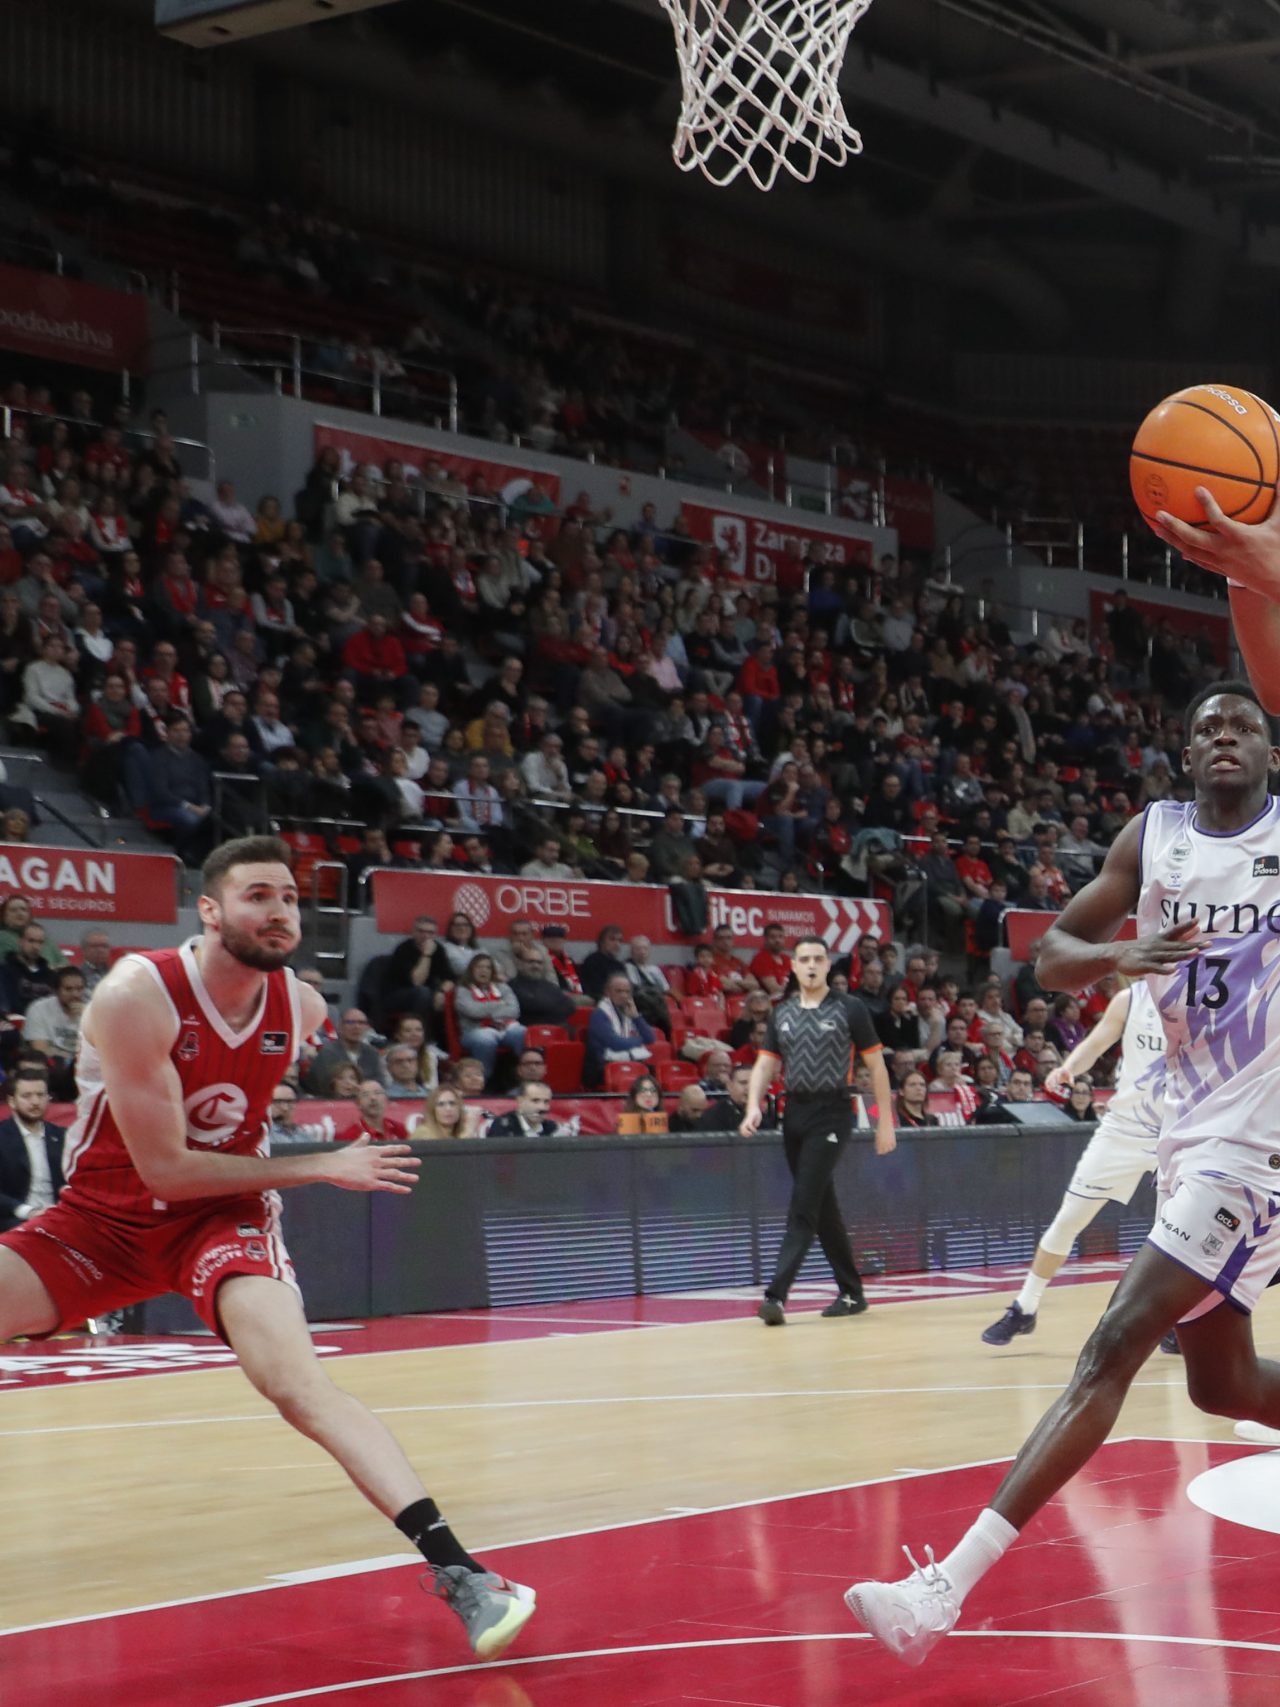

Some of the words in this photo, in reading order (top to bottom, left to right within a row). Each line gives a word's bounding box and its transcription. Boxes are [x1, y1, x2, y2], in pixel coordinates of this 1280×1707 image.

[753, 521, 846, 564] Zargza
[47, 897, 117, 913] SEGUROS
[495, 883, 593, 919] ORBE
[664, 893, 764, 937] itec
[1184, 954, 1232, 1010] 13
[1135, 1033, 1165, 1052] su
[1216, 1213, 1234, 1229] acb
